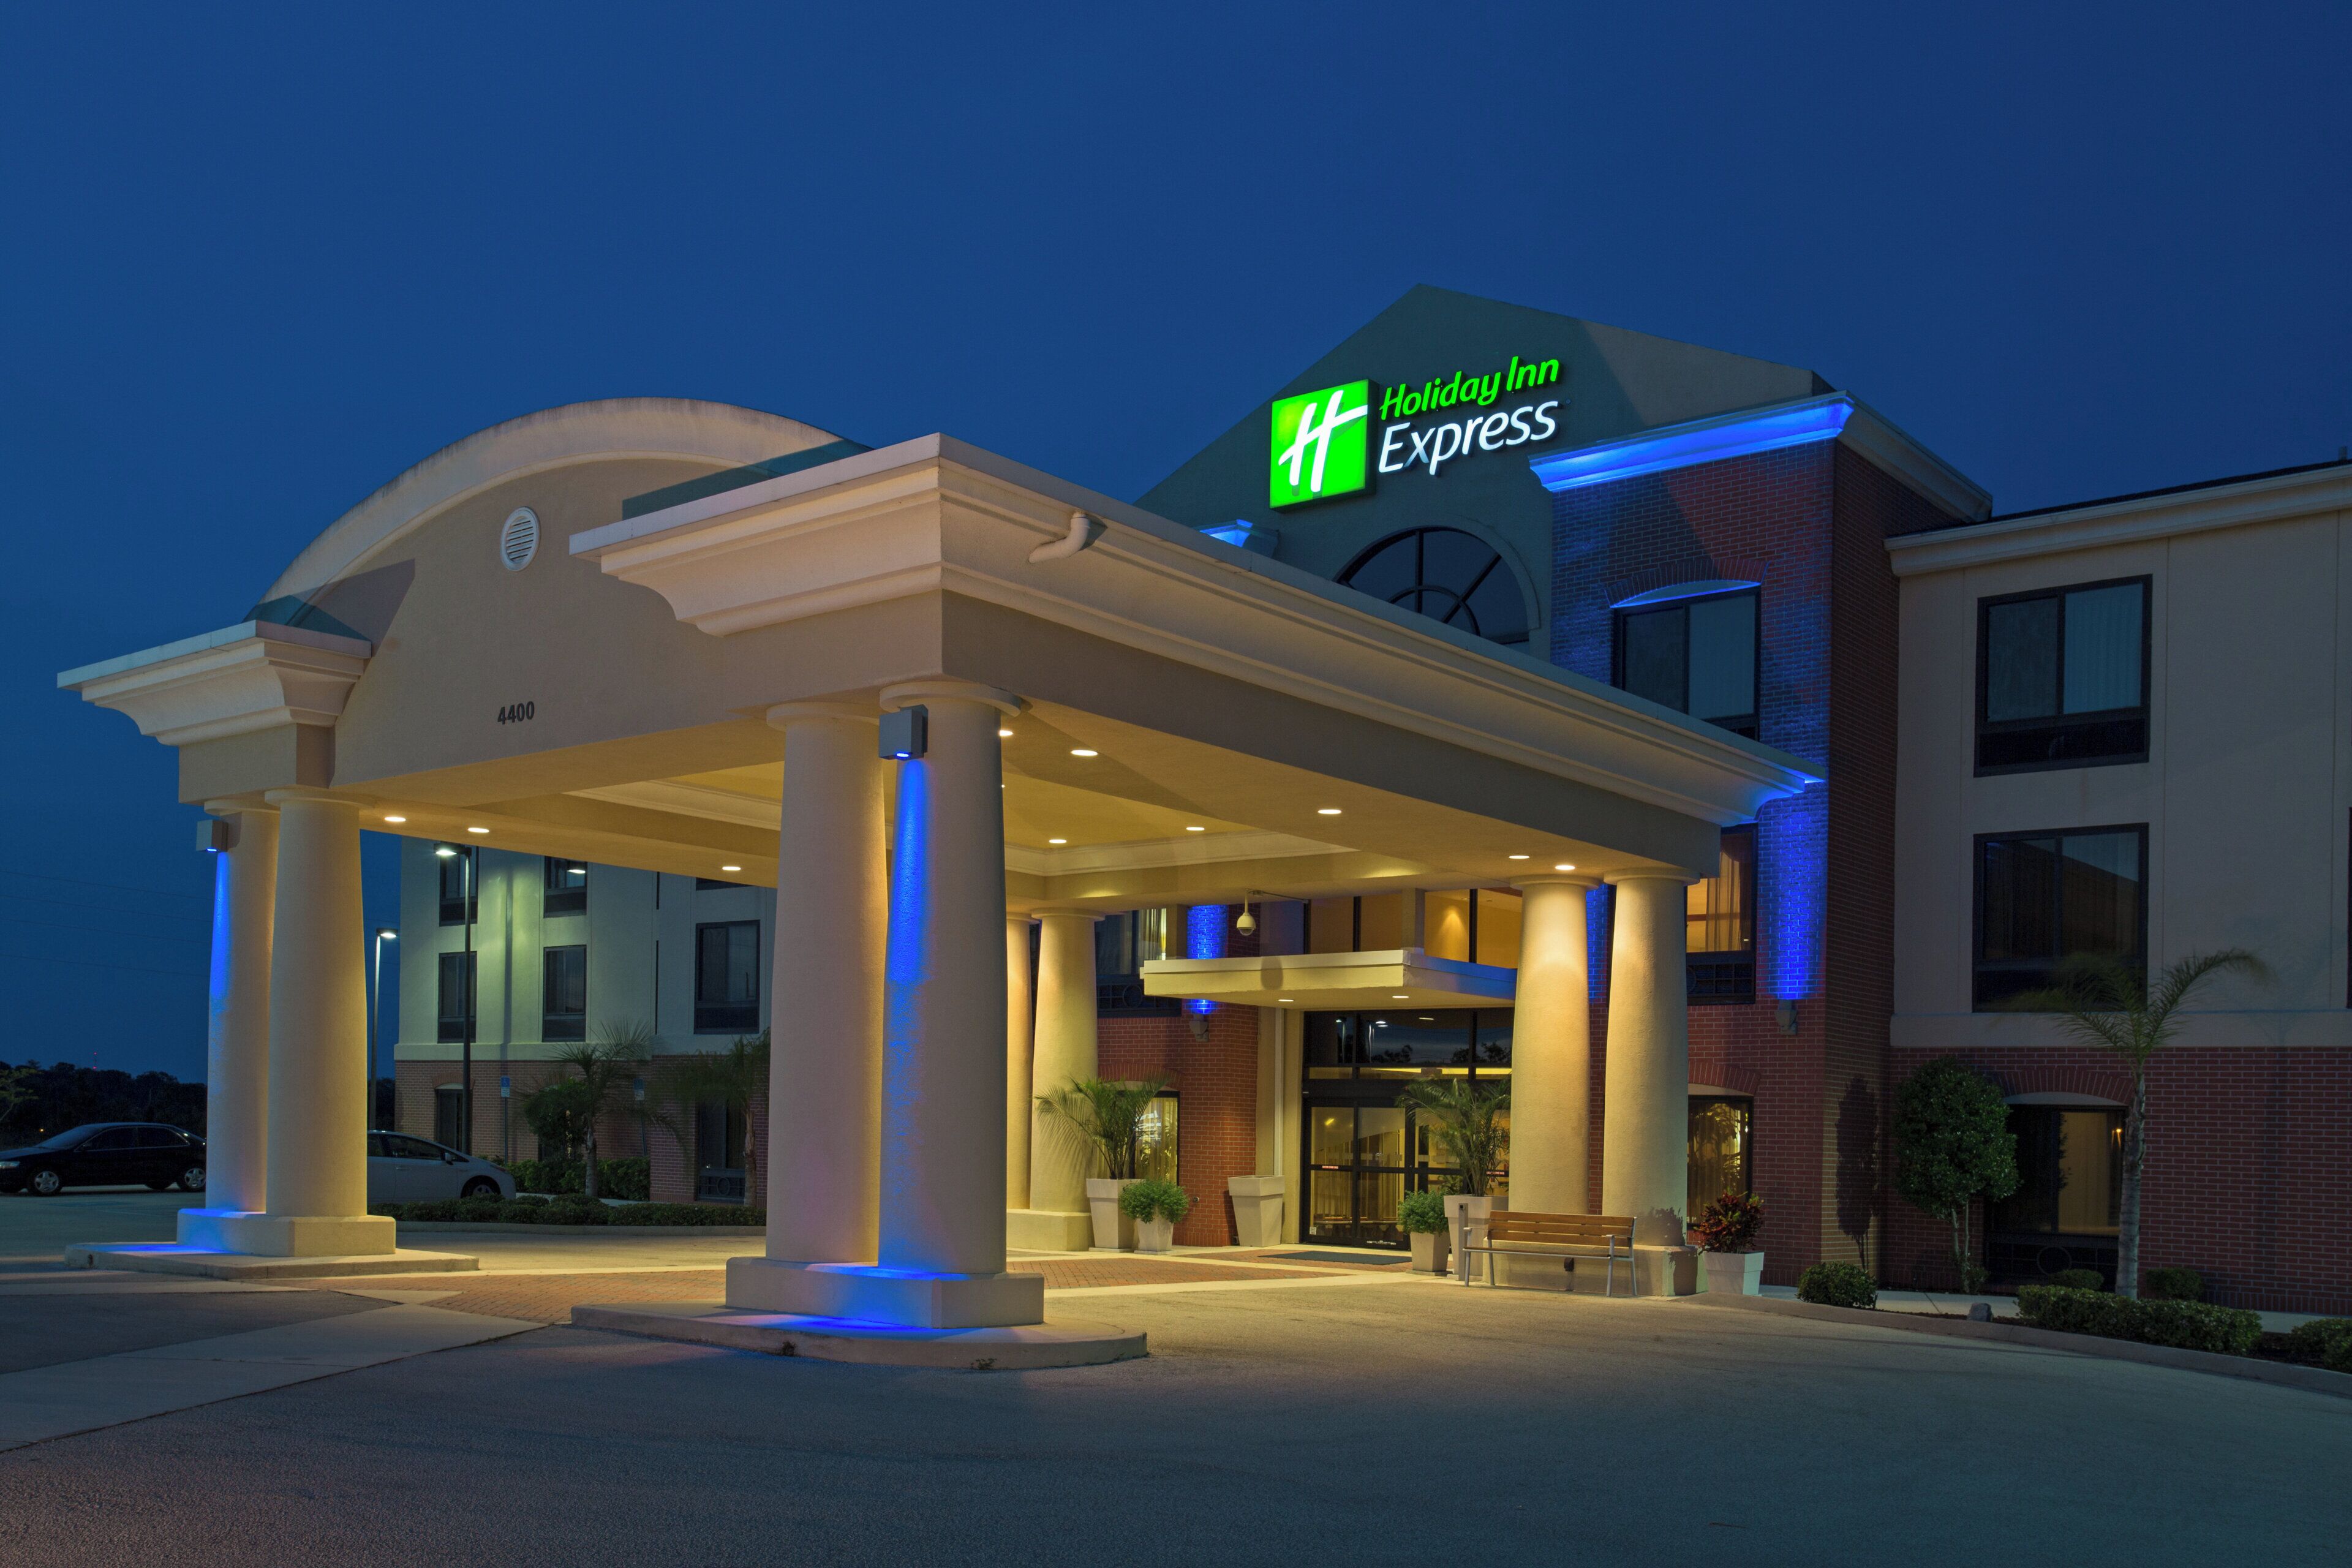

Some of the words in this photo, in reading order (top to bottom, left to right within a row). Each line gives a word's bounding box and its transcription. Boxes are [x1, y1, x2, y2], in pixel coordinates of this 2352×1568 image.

[1379, 371, 1501, 420] Holiday
[1506, 356, 1559, 391] Inn
[1378, 401, 1558, 475] Express
[497, 701, 535, 725] 4400
